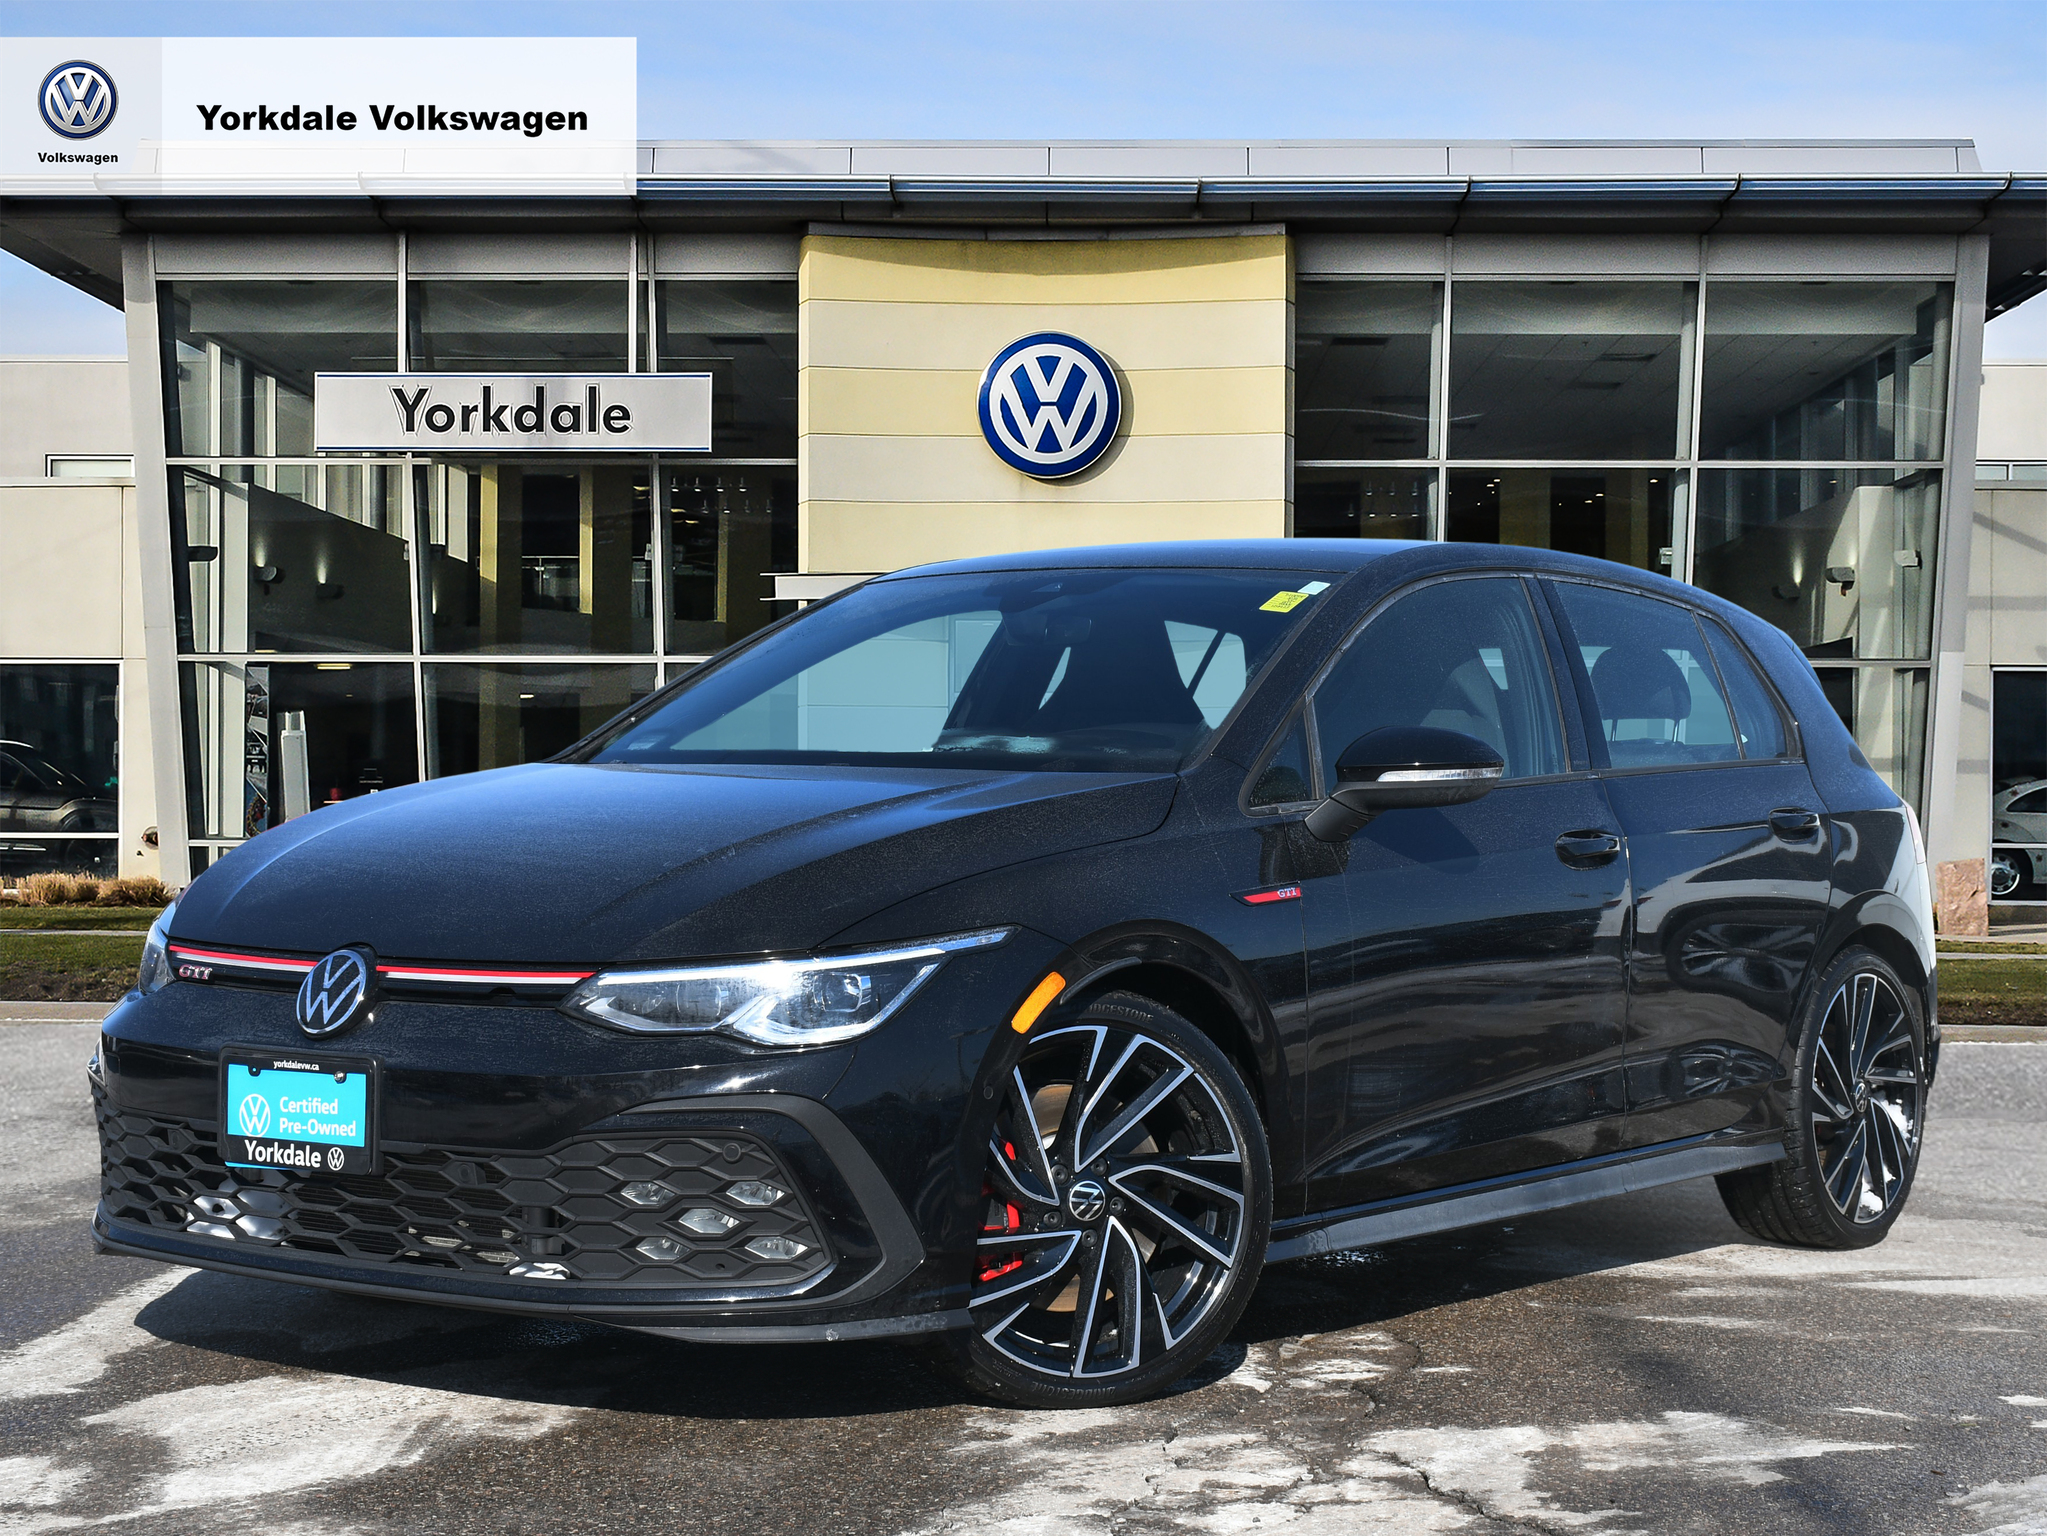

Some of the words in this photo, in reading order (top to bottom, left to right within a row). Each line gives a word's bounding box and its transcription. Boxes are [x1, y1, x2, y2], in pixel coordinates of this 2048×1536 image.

[389, 384, 634, 435] Yorkdale
[1277, 887, 1297, 898] GTI
[178, 963, 213, 980] GTI
[273, 1060, 320, 1071] yorkdalevw.ca
[279, 1096, 338, 1115] Certified
[279, 1117, 356, 1137] Pre-Owned
[244, 1139, 322, 1168] Yorkdale
